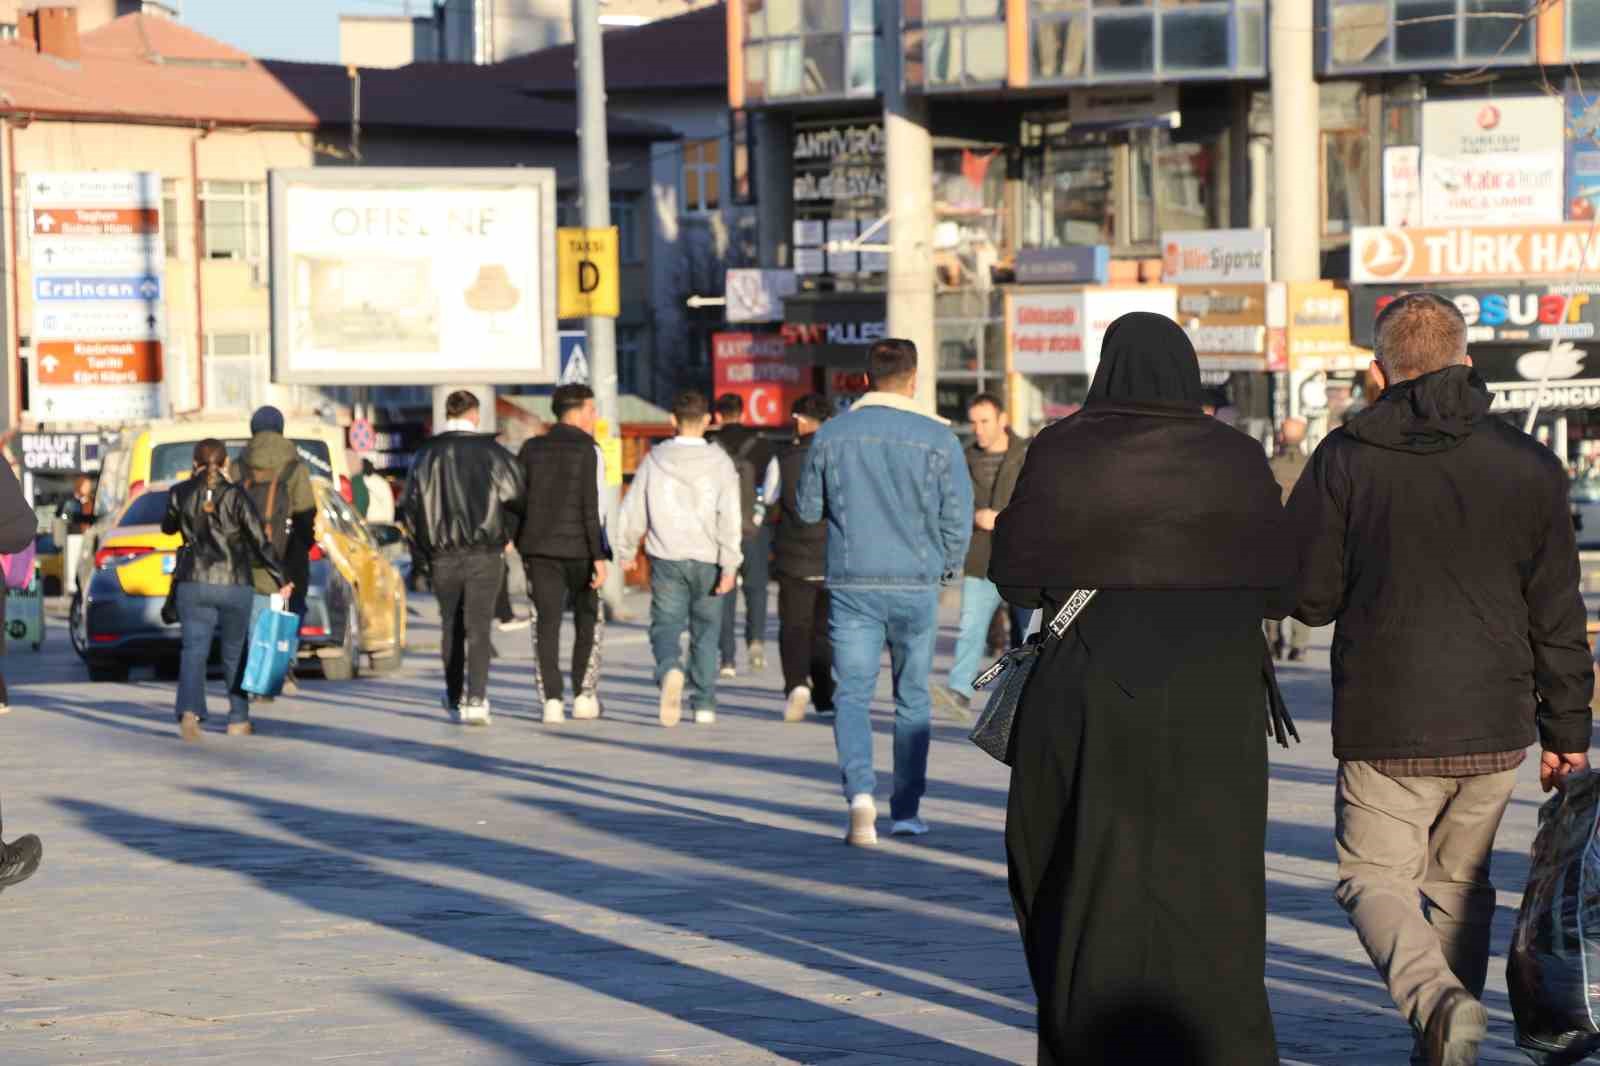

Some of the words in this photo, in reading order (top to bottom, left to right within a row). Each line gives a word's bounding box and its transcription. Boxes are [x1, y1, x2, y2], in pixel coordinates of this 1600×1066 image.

[1424, 229, 1525, 273] TÜRK
[578, 260, 600, 293] D
[22, 434, 78, 452] BULUT
